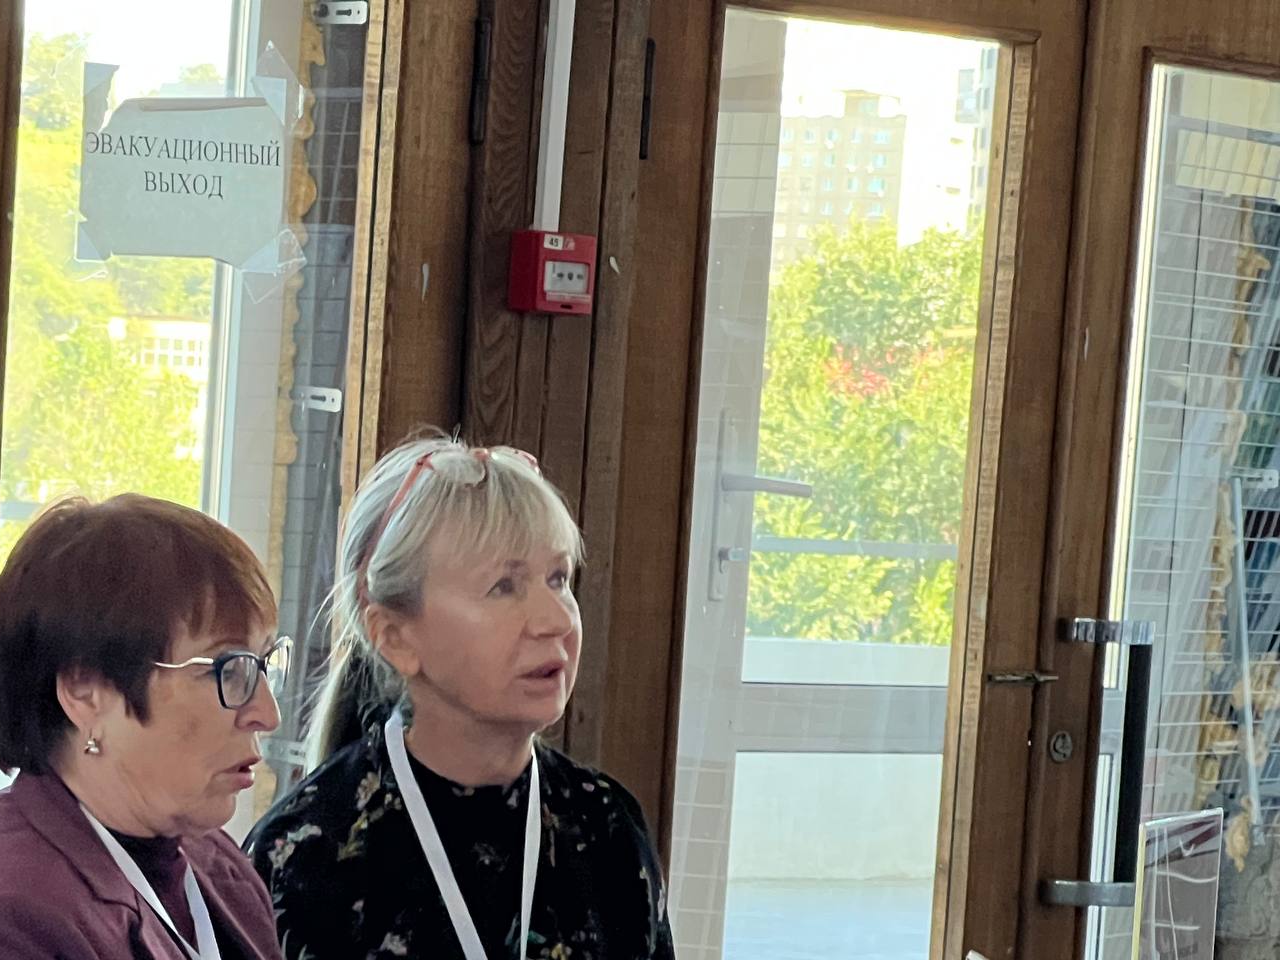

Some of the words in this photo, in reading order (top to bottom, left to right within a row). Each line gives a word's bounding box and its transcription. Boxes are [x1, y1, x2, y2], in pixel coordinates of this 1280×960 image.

[86, 132, 281, 167] ЭВАКУАЦИОННЫЙ
[144, 171, 224, 199] ВЫХОД
[549, 237, 559, 248] 45
